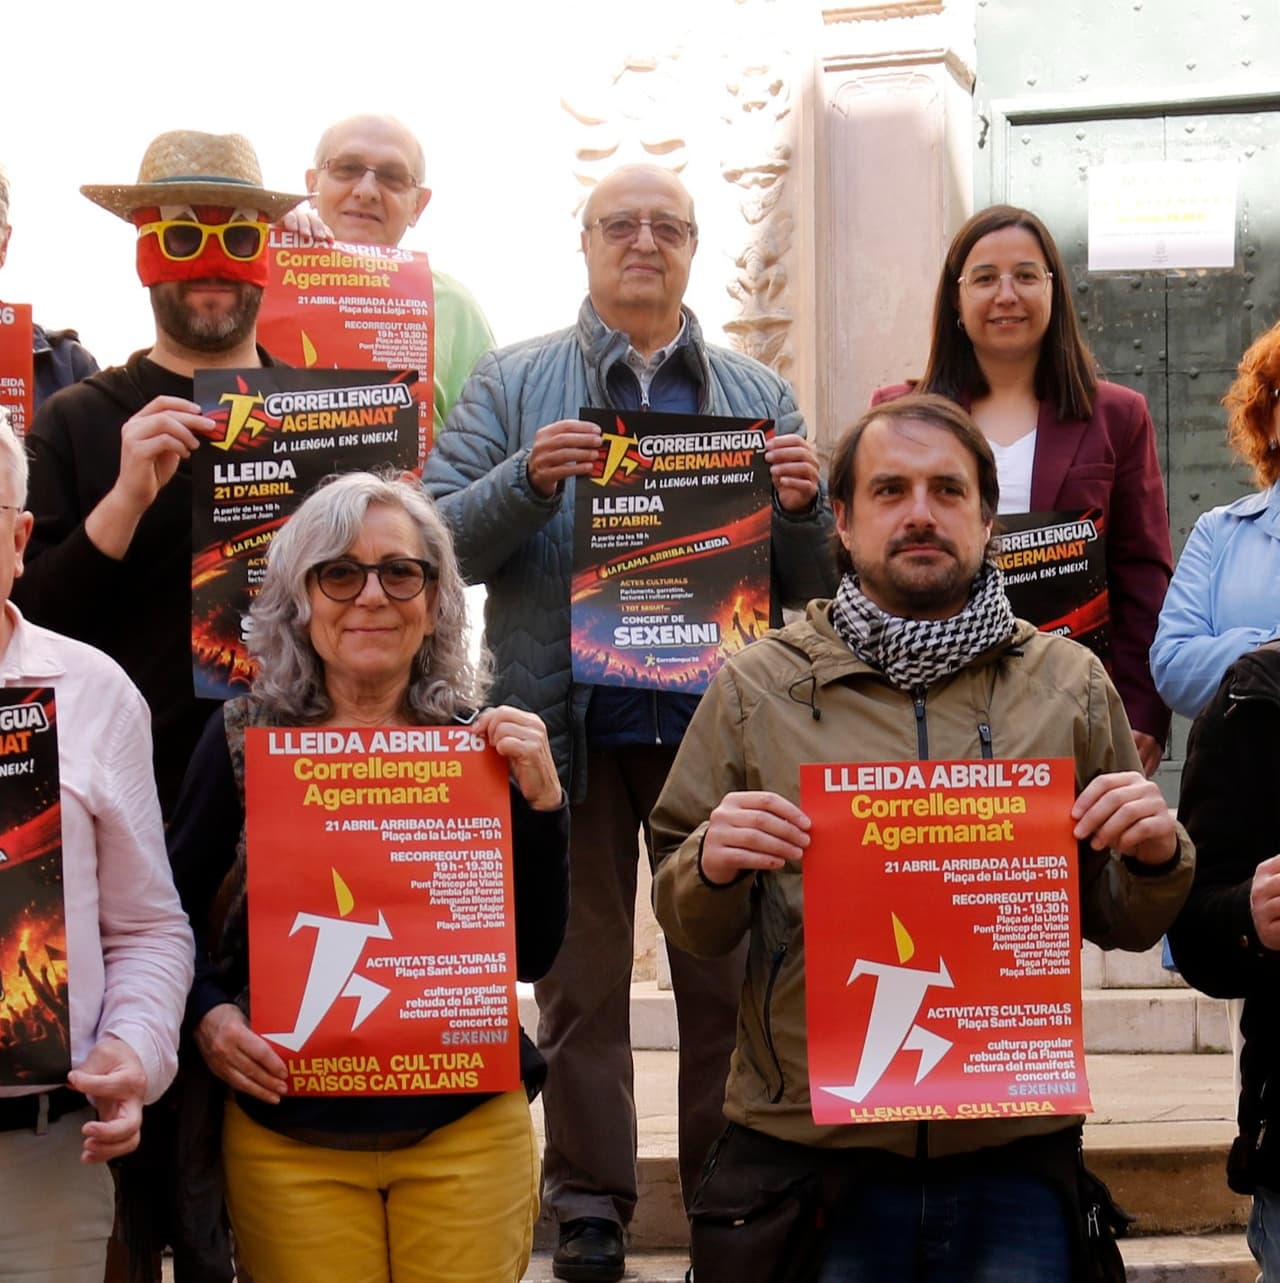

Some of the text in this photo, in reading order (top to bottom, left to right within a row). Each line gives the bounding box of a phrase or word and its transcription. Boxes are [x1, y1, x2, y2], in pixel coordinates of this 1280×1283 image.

[268, 232, 330, 249] LEIDA
[276, 250, 399, 272] Correllengua
[282, 269, 390, 289] Agermanat
[268, 388, 407, 415] CORRELLENGUA
[282, 407, 397, 432] AGERMANAT
[273, 430, 399, 453] LA LLENGUA ENS UNEIX!
[641, 433, 763, 456] CORRELLENGUA
[652, 451, 753, 472] AGERMANAT
[214, 460, 296, 484] LLEIDA
[644, 472, 753, 490] LA LLENGUA ENS UNEIX!
[214, 482, 294, 500] 21 D'ABRIL
[592, 496, 664, 514] LLEIDA
[592, 515, 661, 528] 21 D'ABRIL
[1040, 567, 1056, 579] ENS
[1059, 560, 1088, 576] UNEIX!
[622, 614, 684, 624] CONCERT DE
[614, 623, 718, 646] SEXENNI
[269, 732, 367, 755] LLEIDA
[294, 757, 462, 783] Correllengua
[824, 766, 928, 792] LLEIDA
[304, 783, 449, 810] Agermanat
[852, 794, 1026, 820] Correllengua
[862, 820, 1014, 850] Agermanat
[884, 856, 1068, 872] 21 ABRIL ARRIBADA A LLEIDA
[944, 869, 1068, 884] Plaça de la Llotja 19 h
[952, 888, 1068, 905] RECORREGUT URBÀ
[366, 953, 506, 968] ACTIVITATS CULTURALS
[928, 1003, 1071, 1018] ACTIVITATS CULTURALS
[958, 1016, 1072, 1030] Plaça Sant Joan 18 h
[988, 1038, 1072, 1051] cultura popular
[289, 1053, 484, 1074] LLENGUA CULTURA
[370, 1072, 478, 1090] CATALANS
[850, 1104, 947, 1120] LLENGUA
[958, 1101, 1055, 1114] CULTURA
